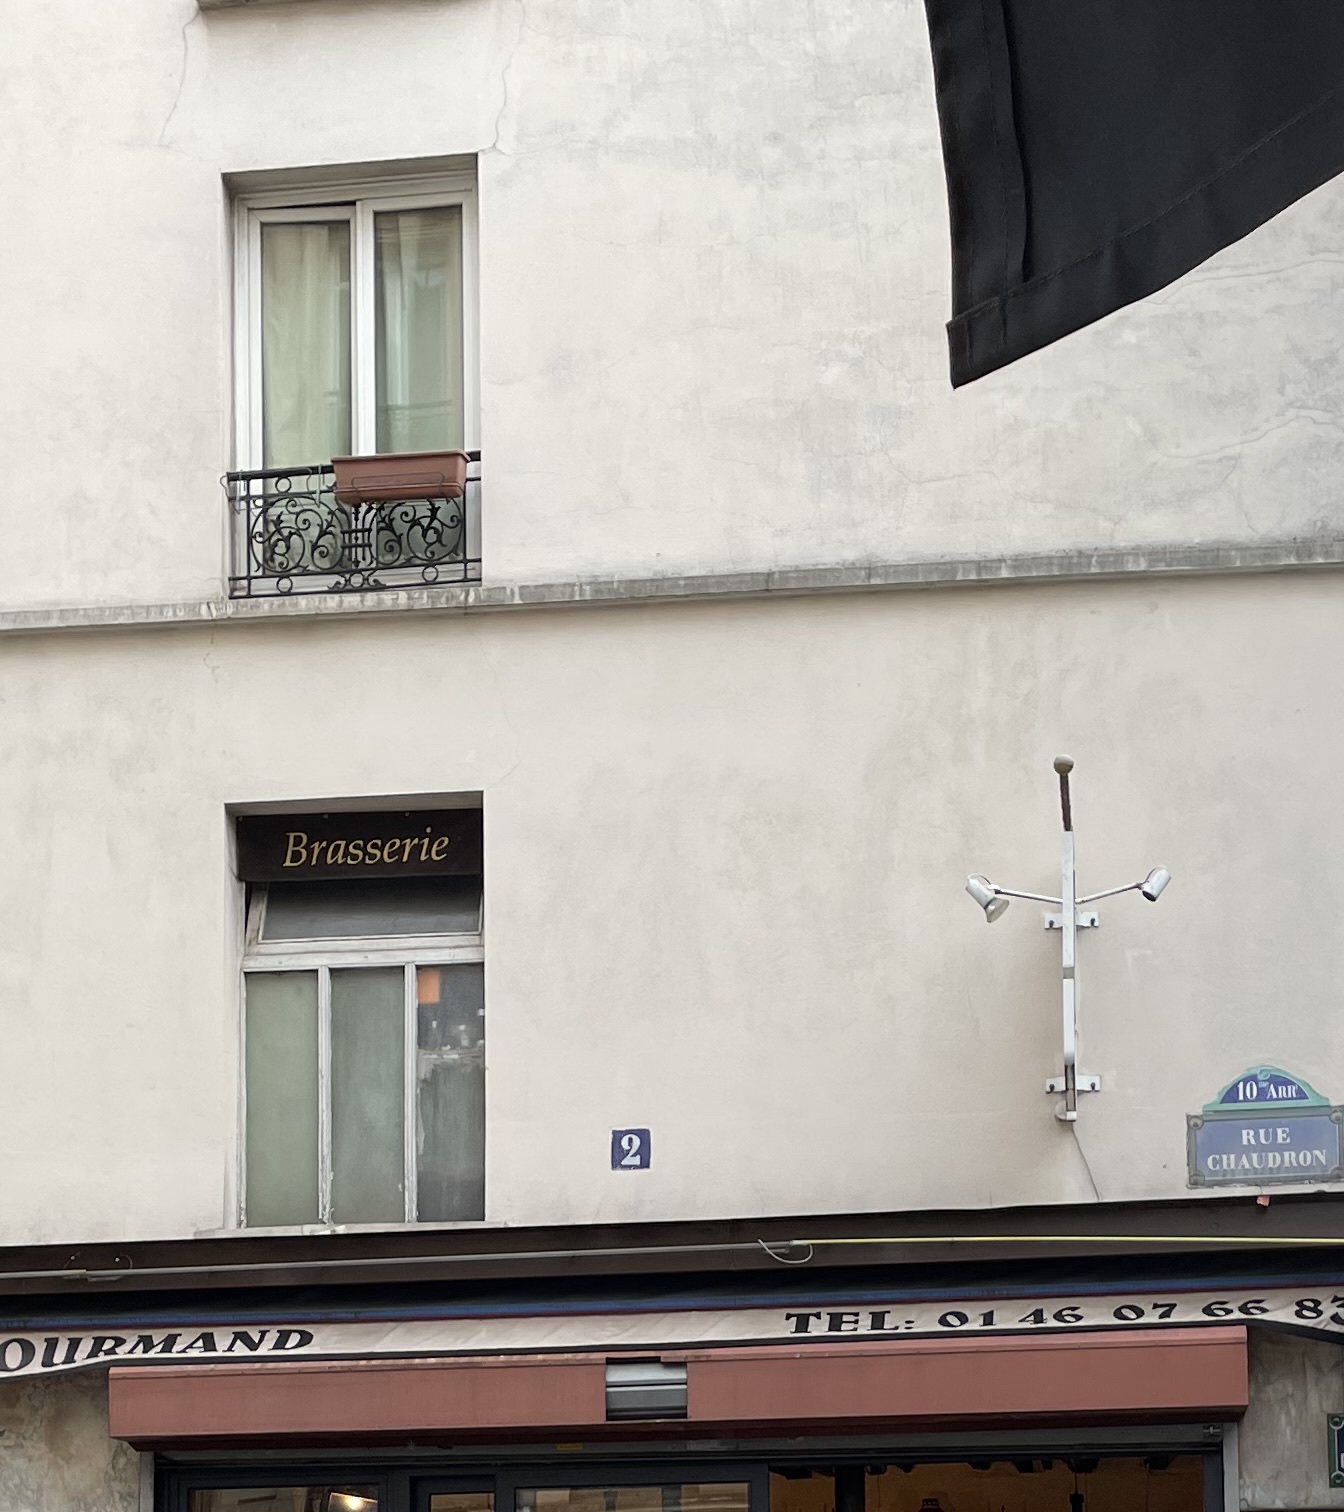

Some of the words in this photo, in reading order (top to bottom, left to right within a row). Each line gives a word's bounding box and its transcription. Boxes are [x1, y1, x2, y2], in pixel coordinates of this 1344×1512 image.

[282, 826, 449, 867] Brasserie
[621, 1133, 641, 1165] 2
[1241, 1127, 1291, 1145] RUE
[1207, 1150, 1327, 1171] CHAUDRON
[785, 1310, 915, 1334] TEL:
[938, 1310, 997, 1327] 01
[1018, 1306, 1084, 1325] 46
[1113, 1302, 1178, 1321] 07
[1202, 1299, 1270, 1318] 66
